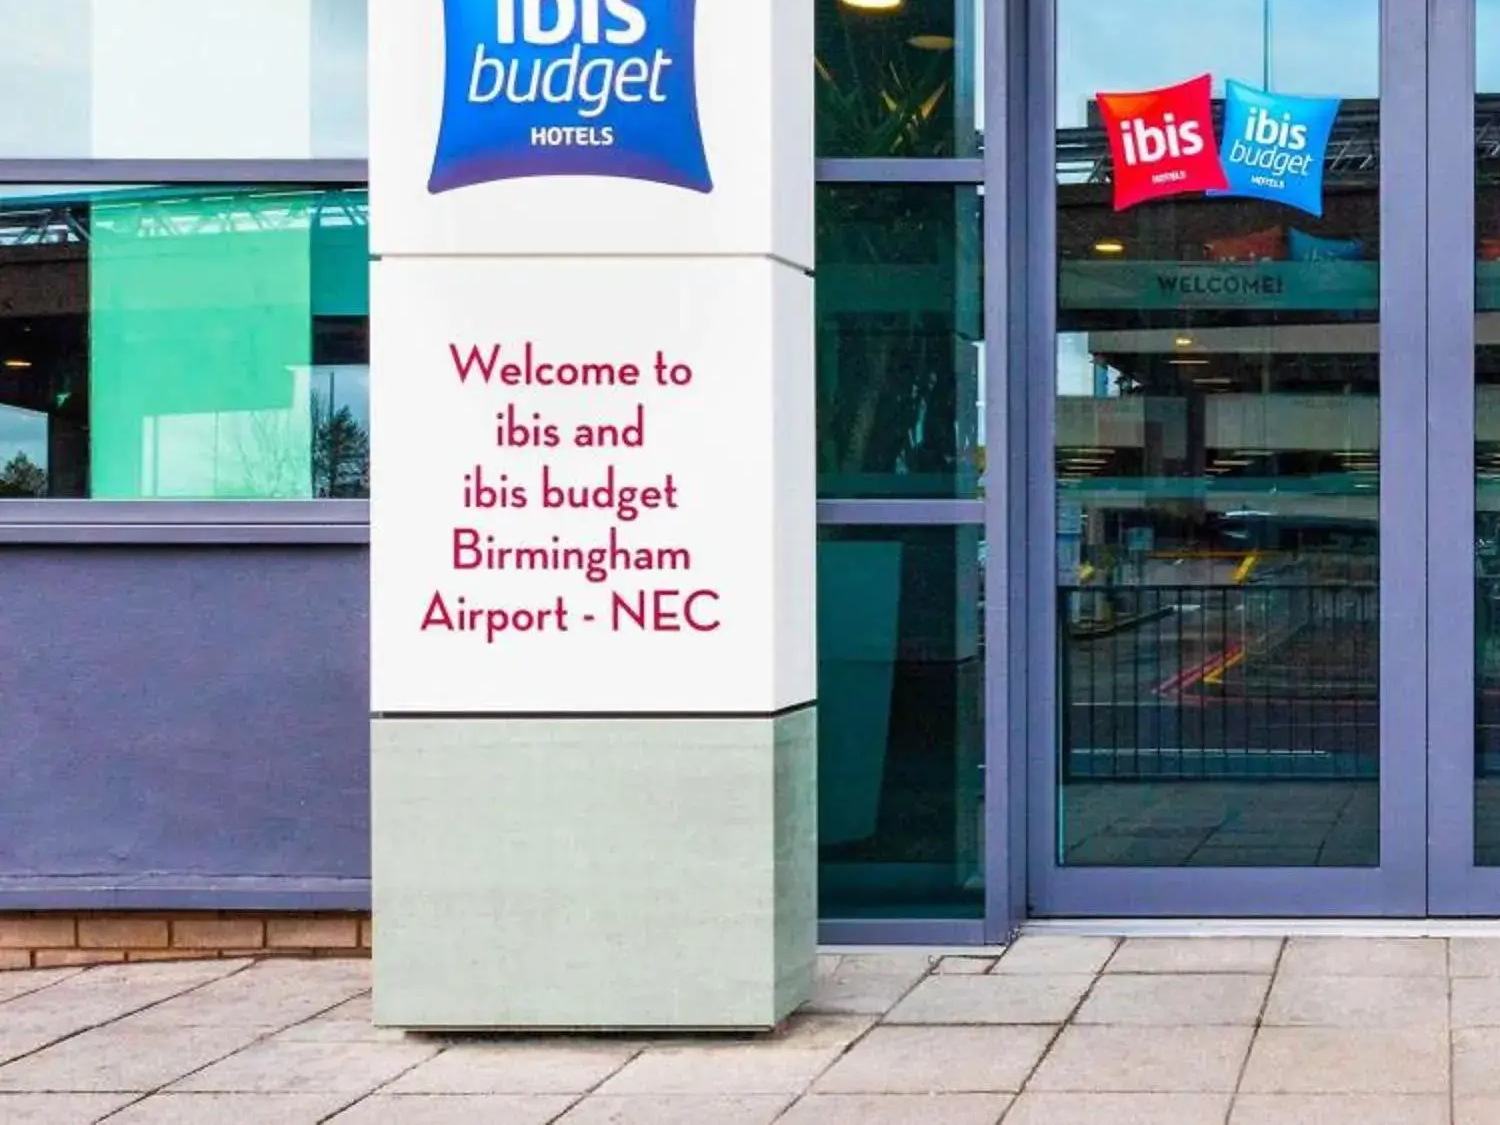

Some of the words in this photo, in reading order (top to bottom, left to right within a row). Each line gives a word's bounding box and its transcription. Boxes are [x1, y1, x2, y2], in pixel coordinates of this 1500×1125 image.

[467, 43, 673, 118] budget
[530, 126, 614, 147] HOTELS
[1120, 112, 1204, 166] ibis
[1245, 106, 1307, 151] ibis
[1229, 139, 1313, 176] budget
[1157, 275, 1284, 295] WELCOME!
[449, 341, 640, 386] Welcome
[653, 350, 693, 386] to
[496, 403, 561, 448] ibis
[573, 403, 644, 448] and
[463, 464, 528, 509] ibis
[542, 464, 679, 522] budget
[453, 526, 691, 583] Birmingham
[420, 590, 568, 644] Airport
[583, 613, 595, 622] -
[612, 588, 721, 632] NEC
